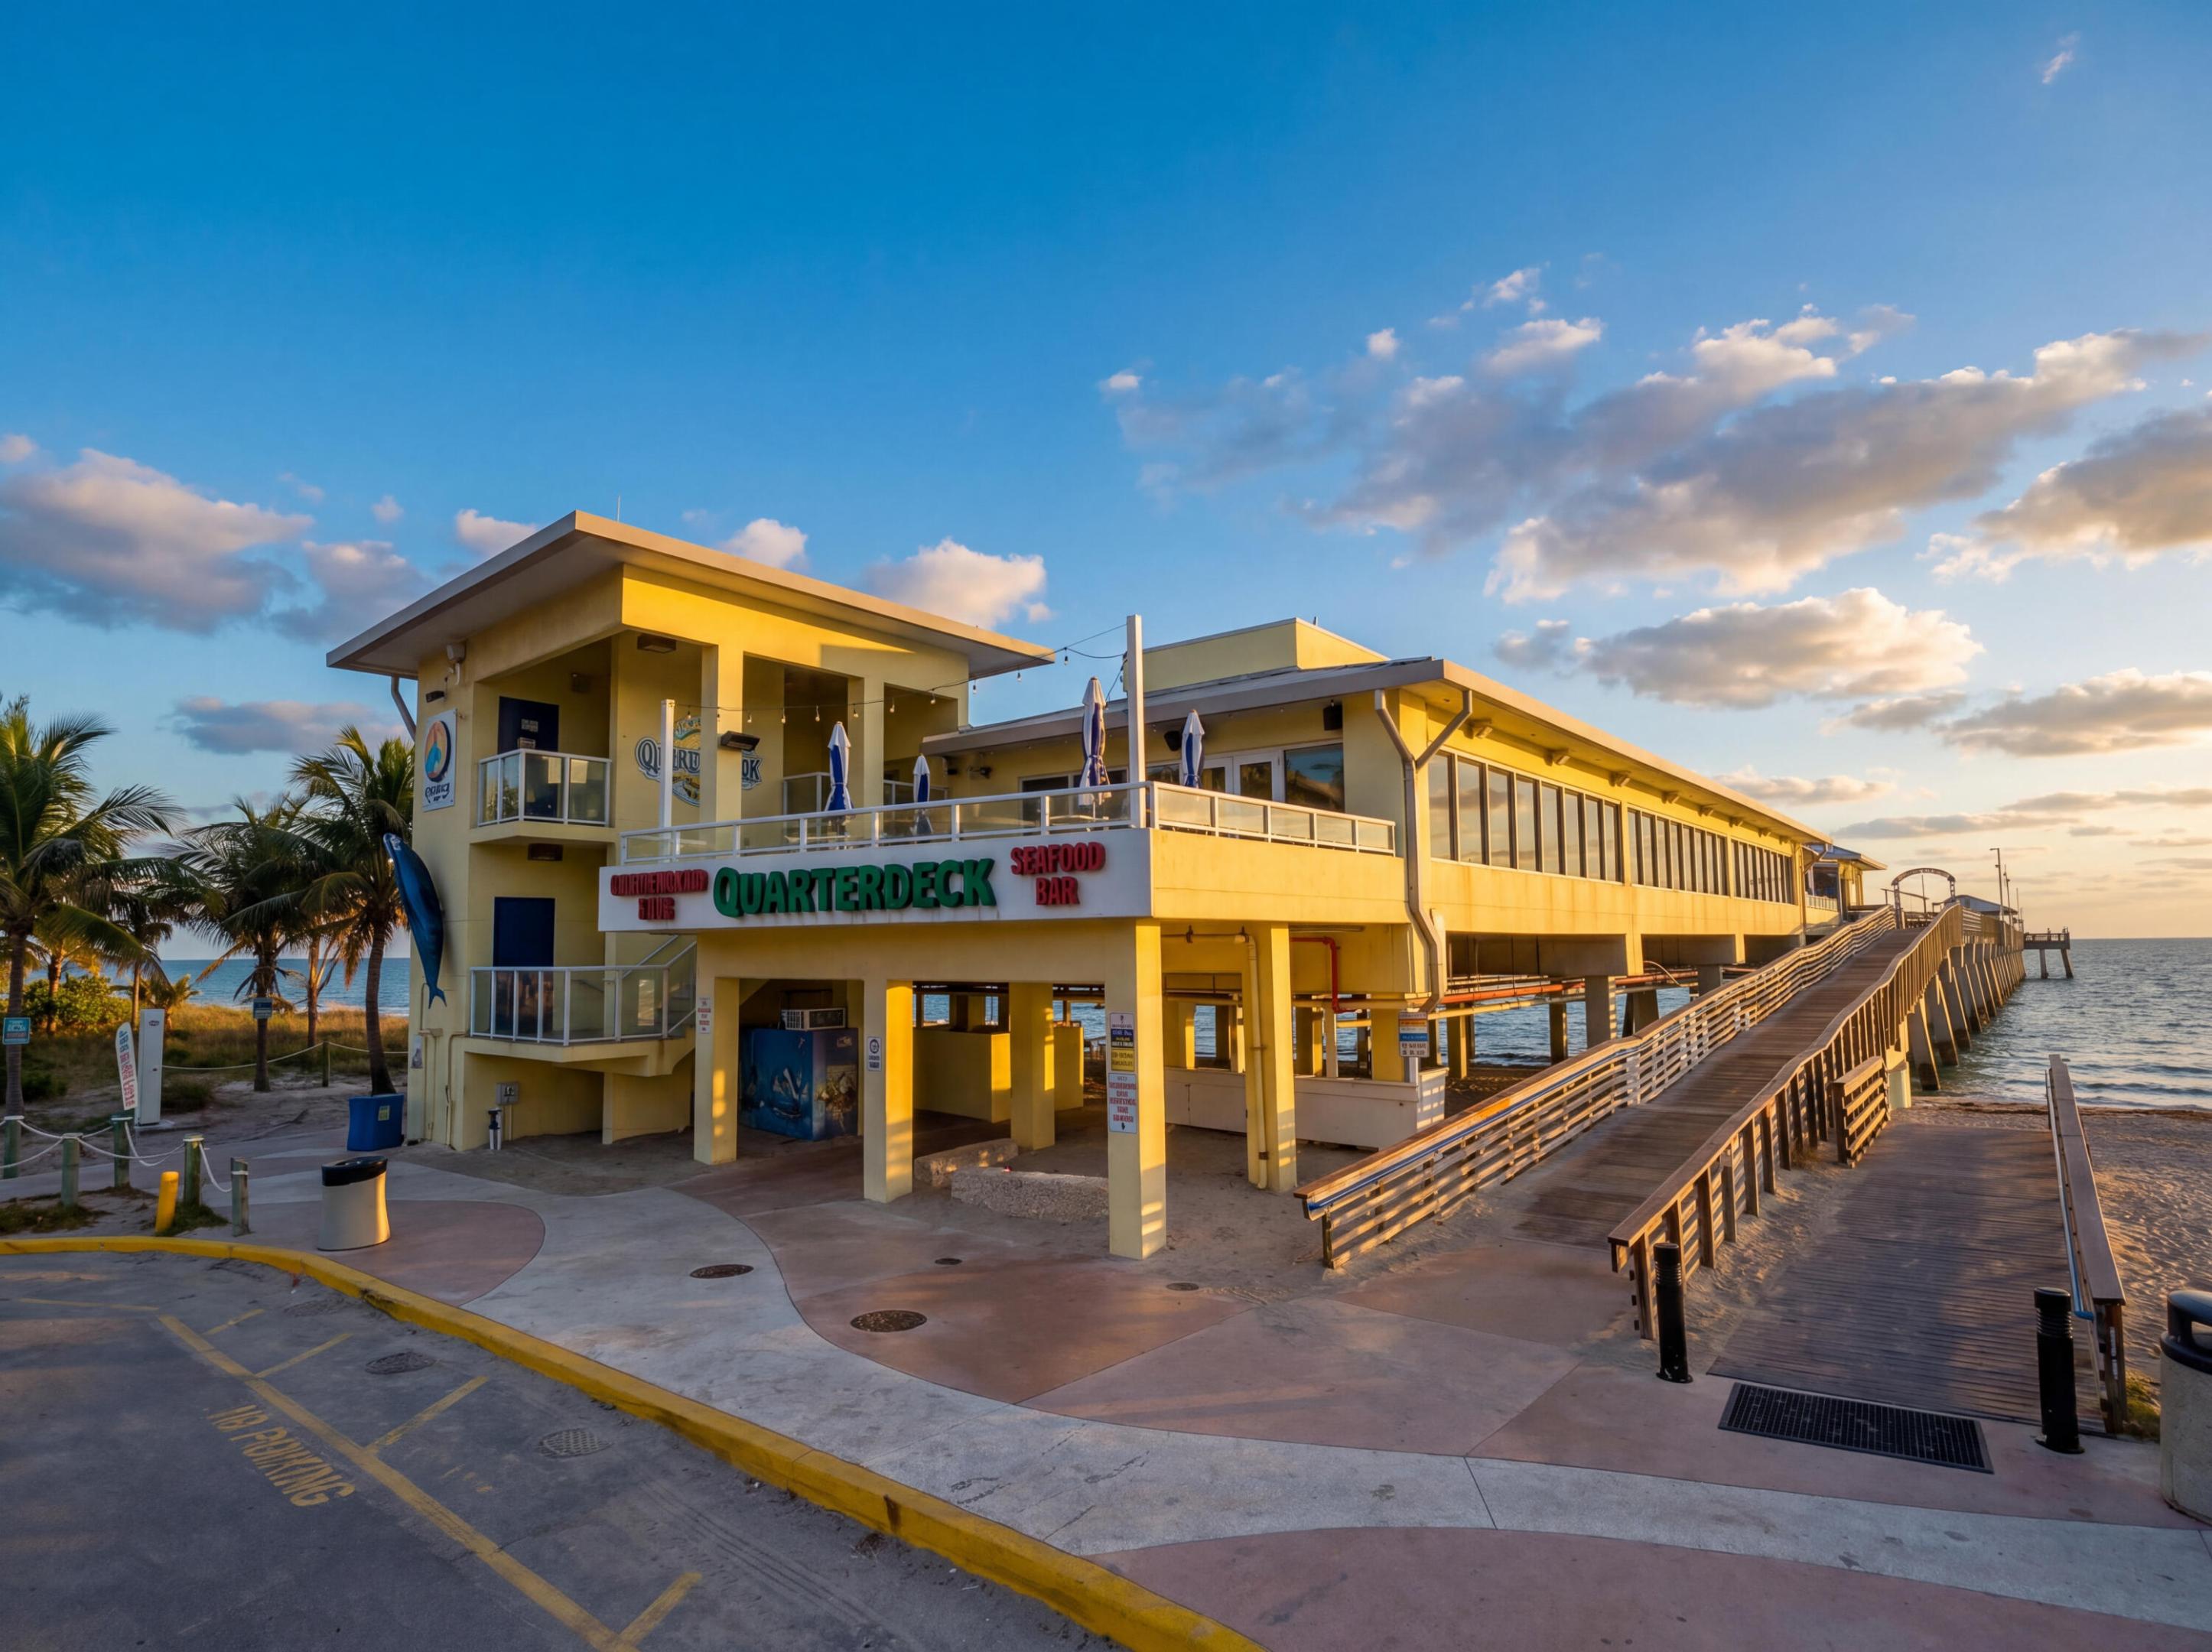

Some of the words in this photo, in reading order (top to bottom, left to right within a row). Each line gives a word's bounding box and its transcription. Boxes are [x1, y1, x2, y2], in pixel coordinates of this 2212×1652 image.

[1010, 841, 1106, 876] SEAFOOD
[713, 858, 997, 919] QUARTERDECK
[1036, 876, 1080, 906] BAR
